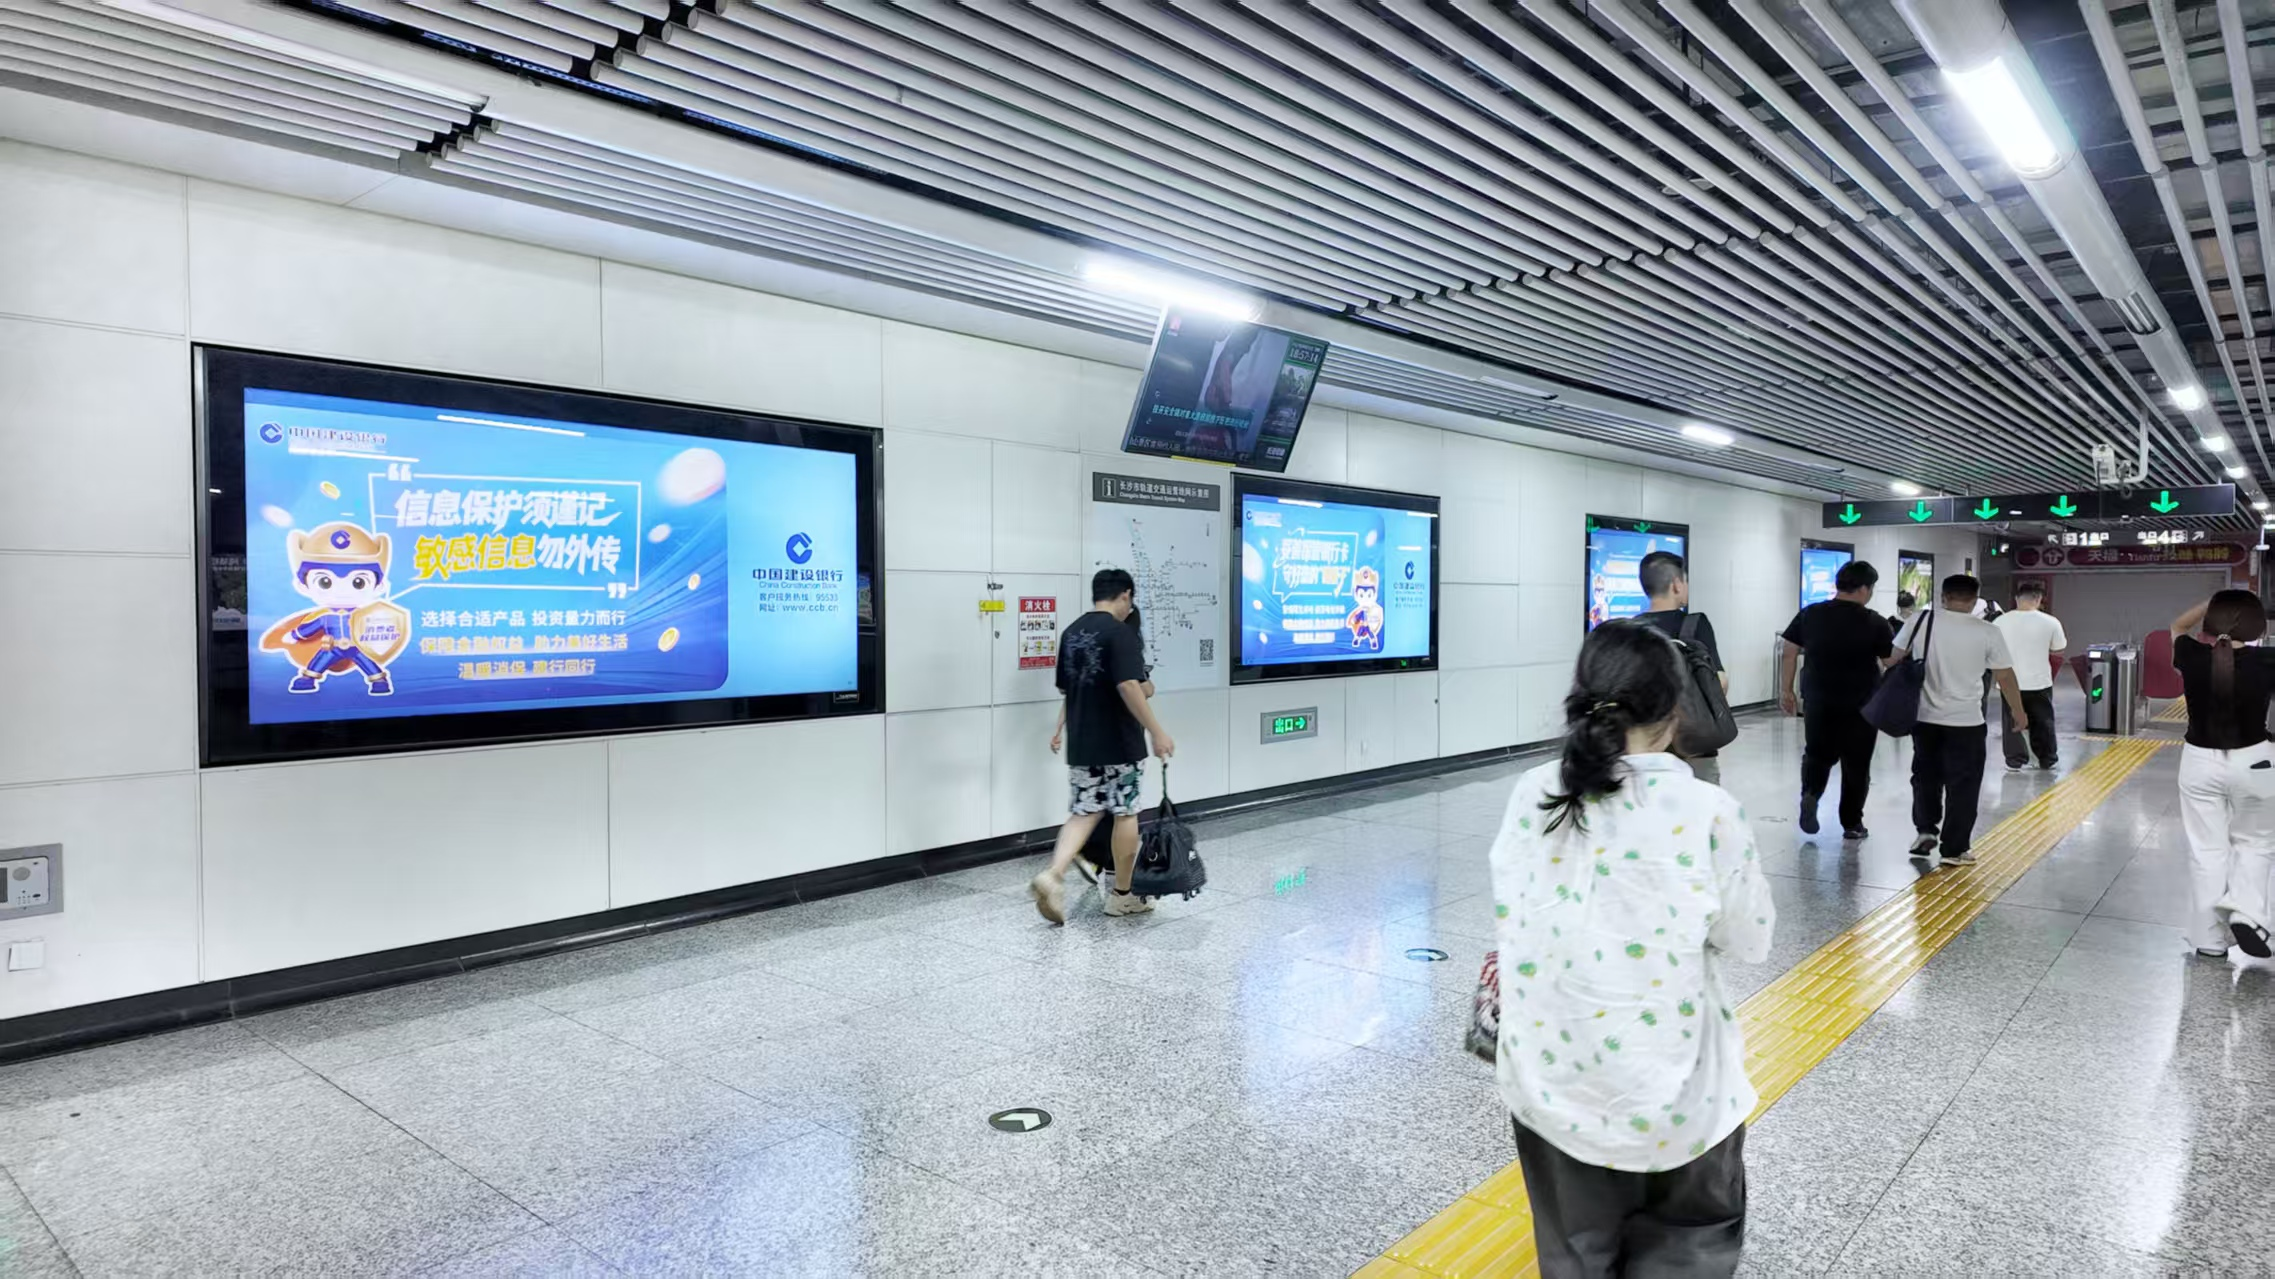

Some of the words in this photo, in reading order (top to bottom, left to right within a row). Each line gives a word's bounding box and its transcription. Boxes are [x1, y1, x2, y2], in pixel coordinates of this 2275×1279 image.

[395, 489, 623, 533] 信息保护须谨记
[410, 533, 621, 580] 敏感信息勿外传
[752, 568, 843, 582] 中国建设银行
[1025, 600, 1051, 611] 消火栓
[421, 611, 526, 627] 选择合适产品
[532, 610, 627, 627] 投资量力而行
[1275, 718, 1293, 734] 出口
